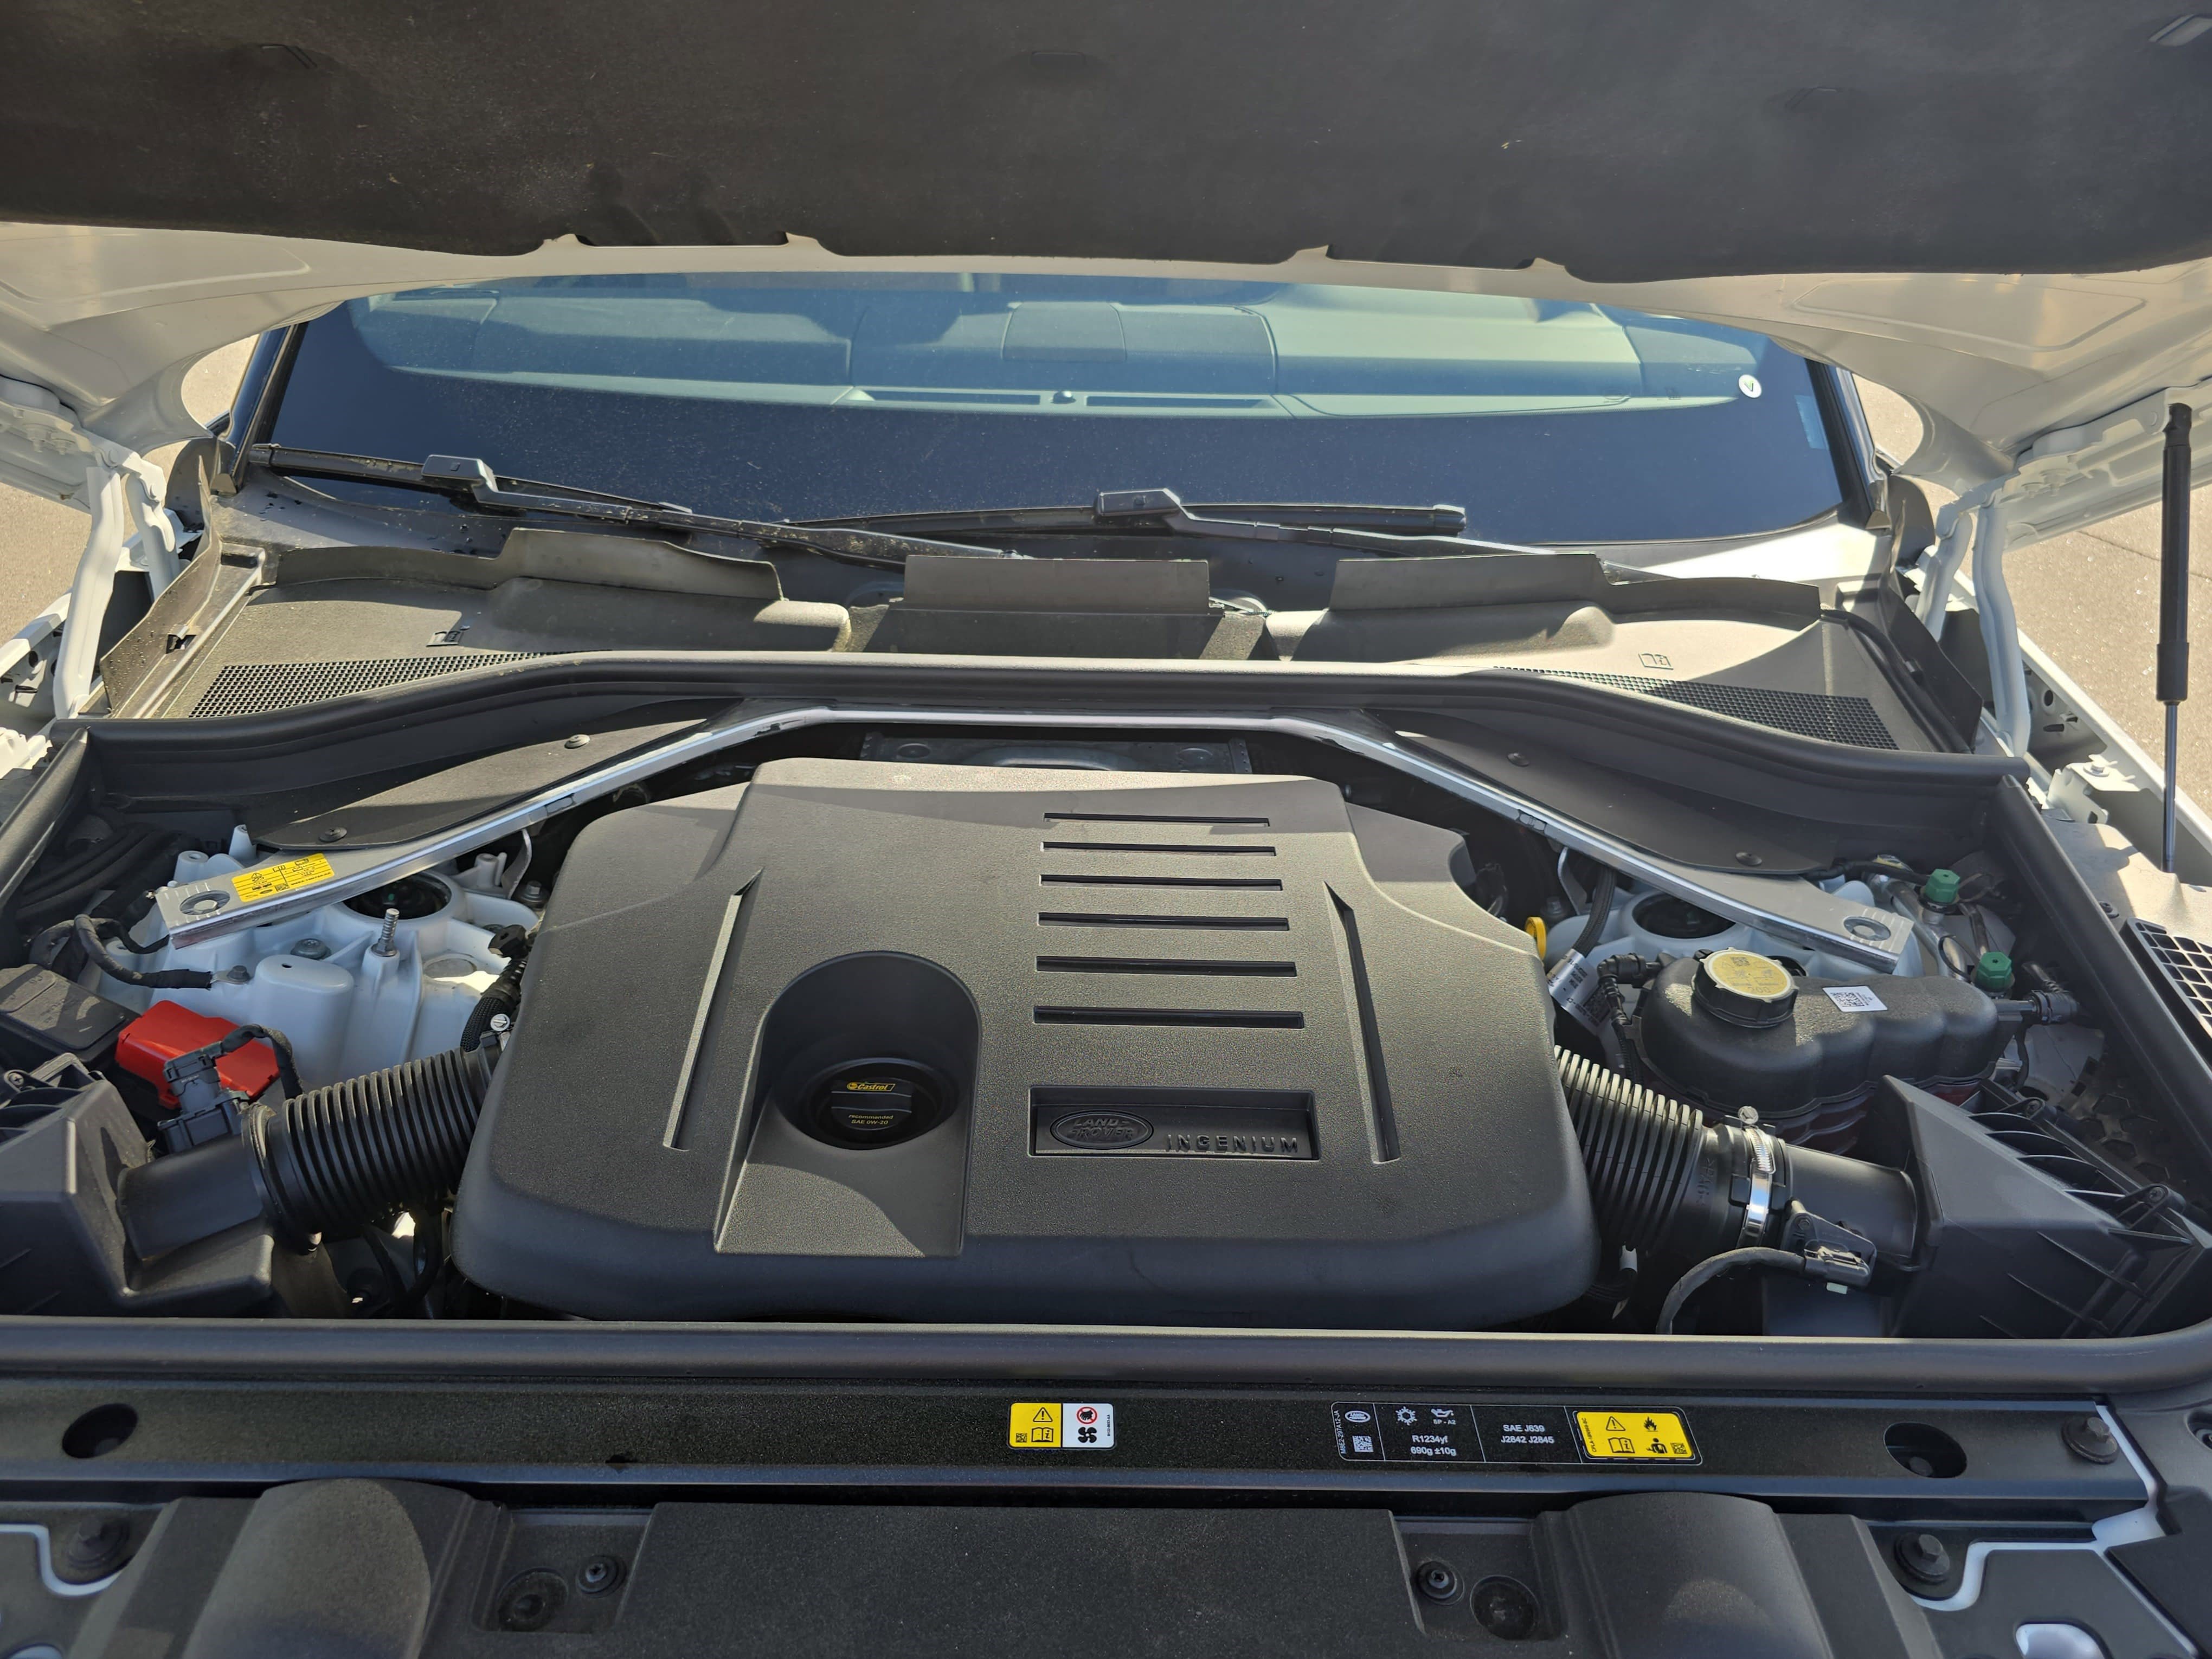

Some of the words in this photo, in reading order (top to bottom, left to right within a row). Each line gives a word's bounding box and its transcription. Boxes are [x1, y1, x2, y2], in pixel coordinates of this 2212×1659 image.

[1073, 1118, 1118, 1127] LAND
[1075, 1127, 1135, 1140] ROVER
[1165, 1134, 1299, 1154] INGENIUM
[1524, 1424, 1545, 1432] J639
[1412, 1435, 1448, 1444] R1234yf
[1528, 1436, 1555, 1444] J2845
[1410, 1446, 1433, 1456] 690g
[1435, 1446, 1457, 1457] ±10g
